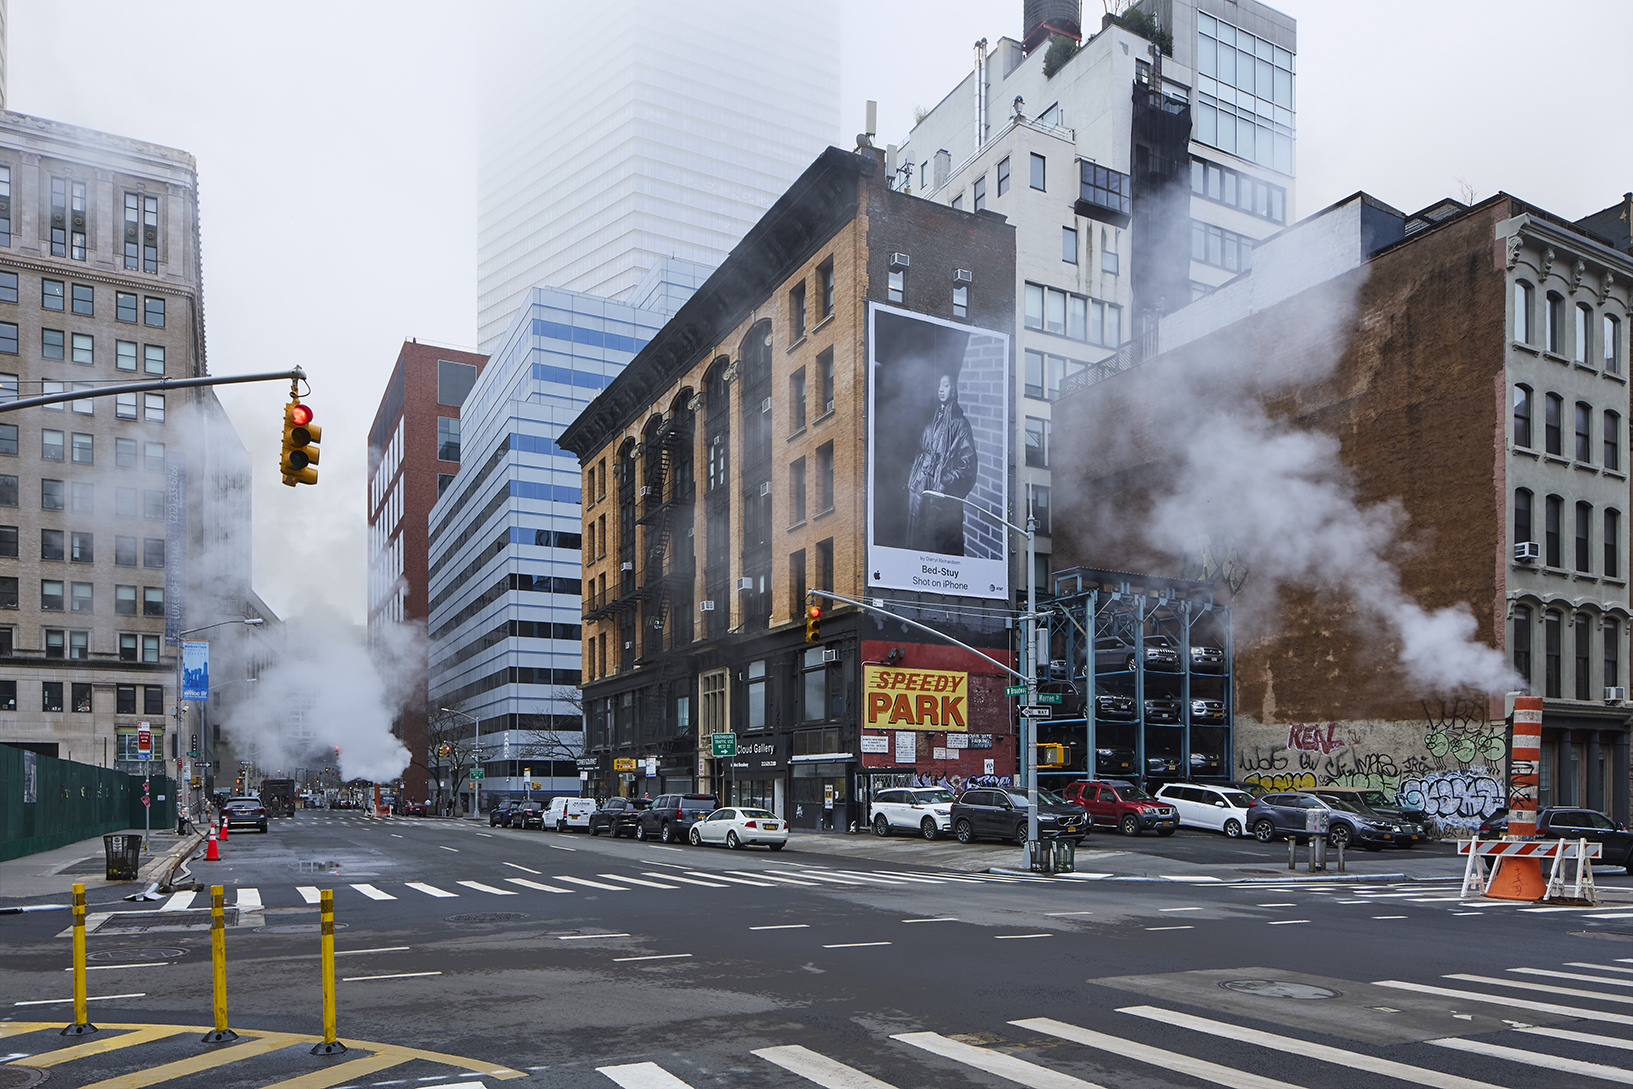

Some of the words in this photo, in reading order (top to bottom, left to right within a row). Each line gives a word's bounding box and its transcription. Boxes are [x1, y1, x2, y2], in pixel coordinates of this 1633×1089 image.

[172, 540, 180, 574] RENTALS
[922, 565, 959, 578] Bed-Stuy
[172, 577, 180, 597] LOFT
[912, 576, 930, 586] Shot
[943, 580, 968, 590] iPhone
[172, 598, 180, 618] LUXE
[874, 671, 965, 693] SPEEDY
[868, 692, 965, 726] PARK
[737, 744, 752, 754] Cloud
[754, 743, 775, 755] Gallery
[1287, 722, 1346, 756] REAL
